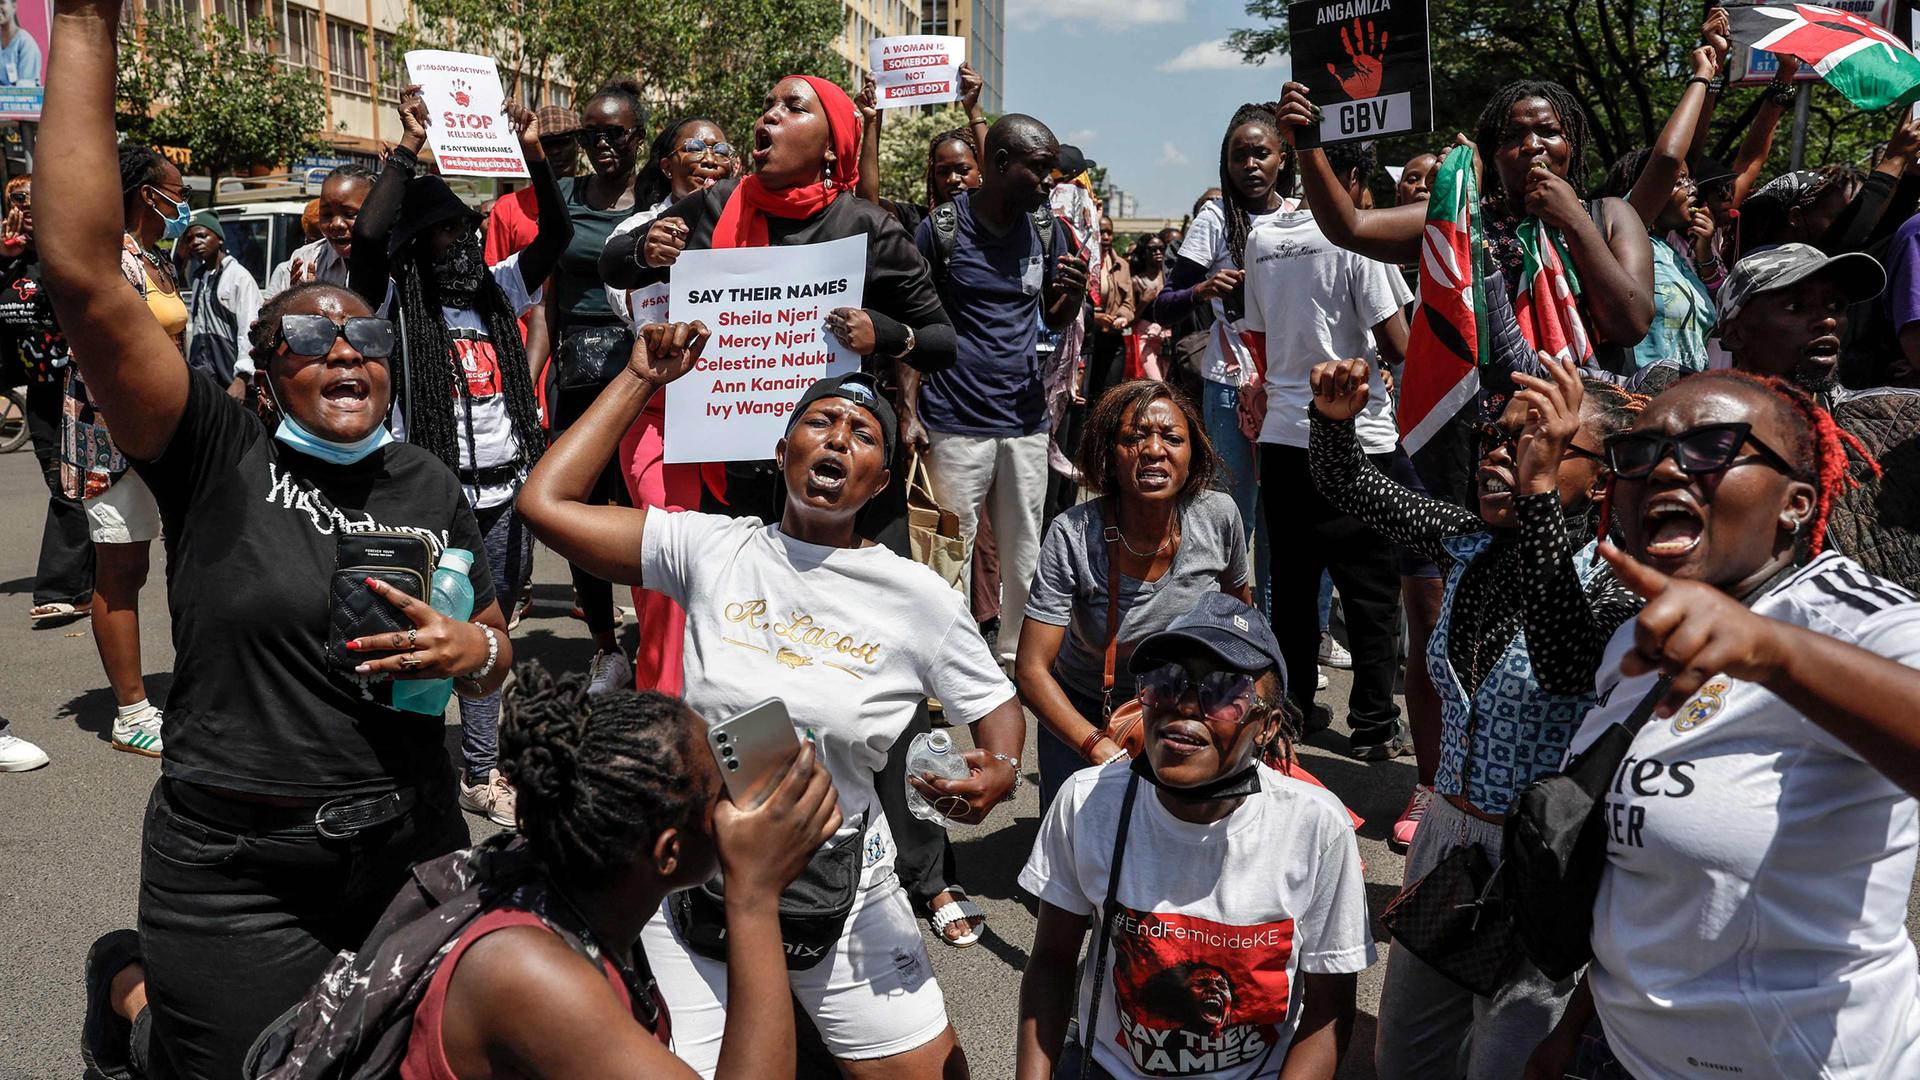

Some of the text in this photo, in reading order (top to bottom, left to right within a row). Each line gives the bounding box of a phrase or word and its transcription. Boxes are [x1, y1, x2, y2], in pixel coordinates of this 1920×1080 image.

[1316, 0, 1391, 25] ANGAMIZA
[883, 46, 890, 55] A
[893, 43, 933, 53] WOMAN
[889, 56, 942, 69] SOMEBODY
[905, 71, 925, 81] NOT
[890, 83, 946, 97] SOME BODY
[443, 111, 493, 129] STOP
[1340, 99, 1388, 135] GBV
[447, 130, 497, 140] KILLING US
[440, 144, 513, 153] #SAYTHEIRNAMES
[688, 278, 848, 304] SAY THEIR NAMES
[718, 305, 818, 327] Sheila Njeri
[718, 327, 816, 350] Mercy Njeri
[695, 350, 836, 372] Celestine Nduku
[712, 380, 746, 394] Ann
[706, 402, 732, 420] Ivy
[724, 599, 769, 631] R.
[1113, 912, 1280, 949] #EndFemicideKE
[1120, 1009, 1169, 1048] SAY
[1123, 1030, 1266, 1073] NAMES
